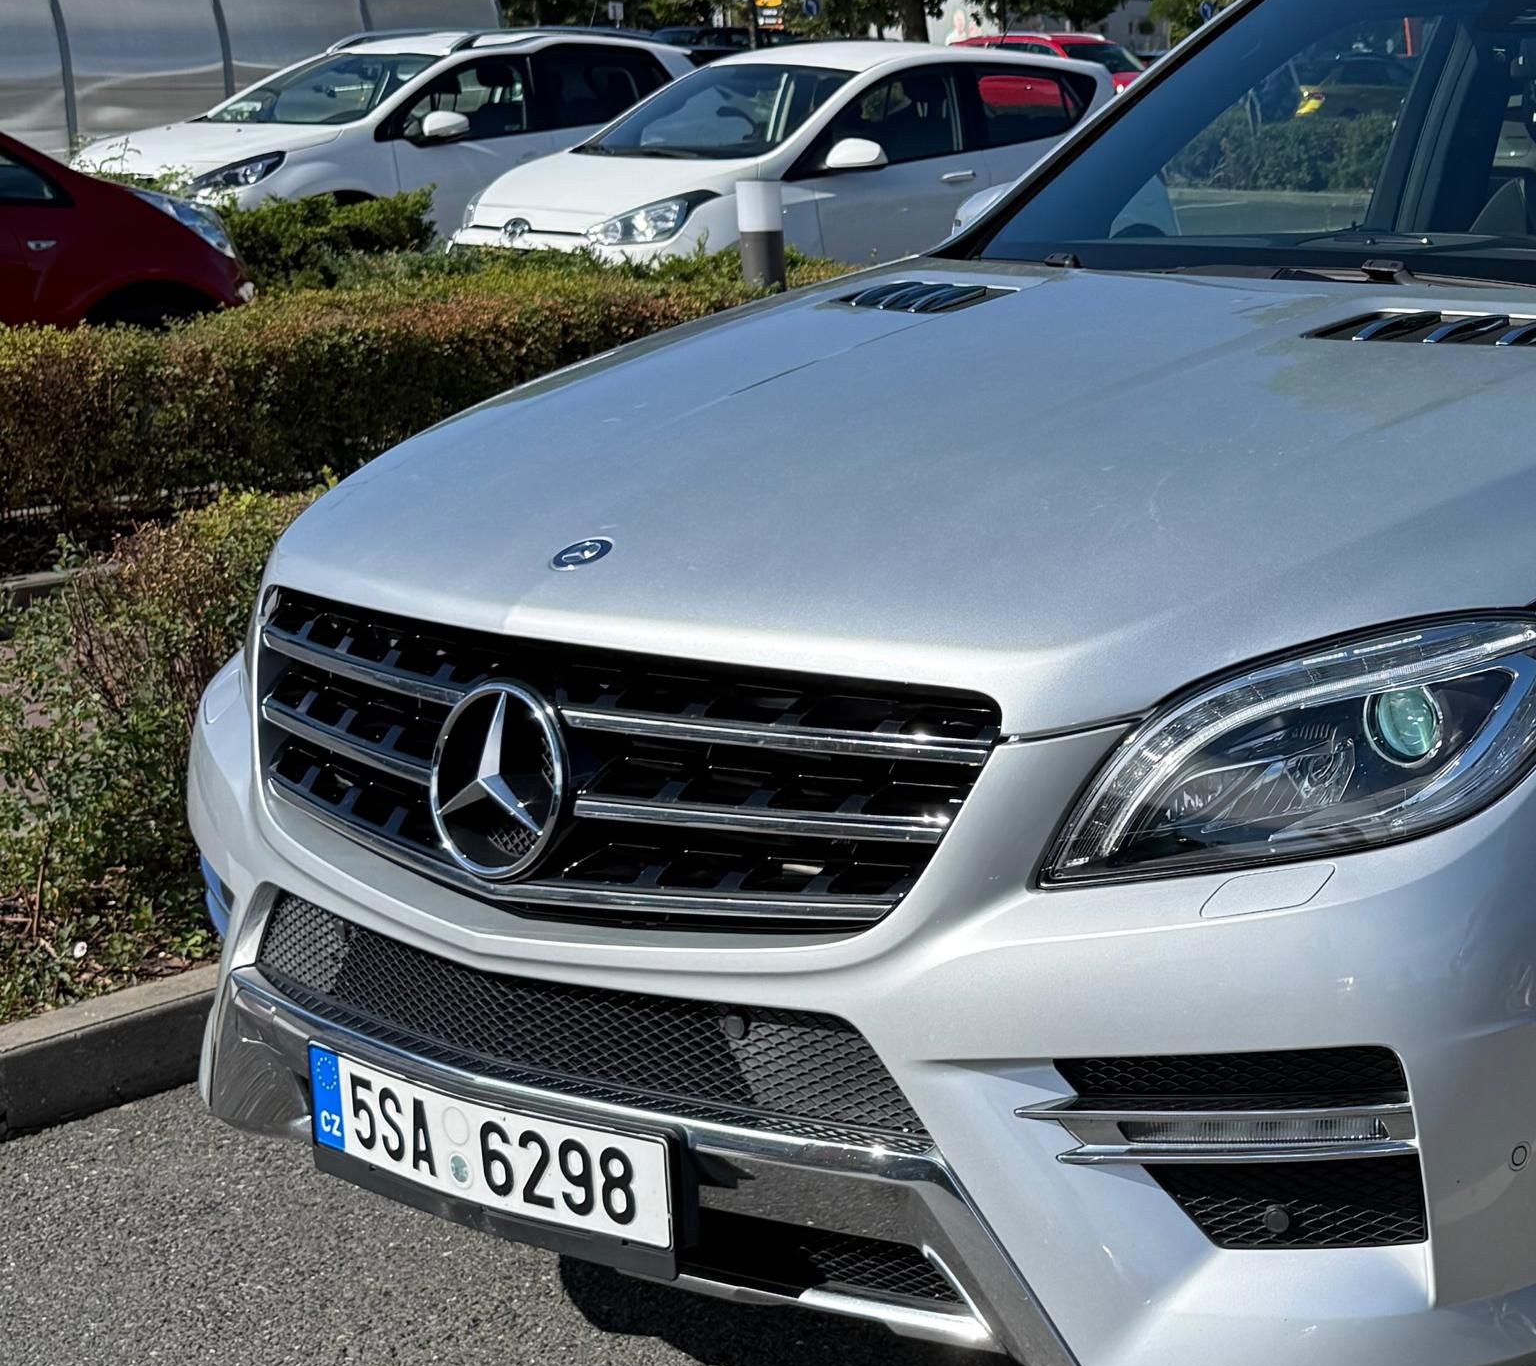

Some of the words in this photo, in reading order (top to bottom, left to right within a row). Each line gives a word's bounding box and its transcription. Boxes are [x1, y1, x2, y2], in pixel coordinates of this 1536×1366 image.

[320, 1109, 342, 1137] CZ
[349, 1072, 438, 1179] 5SA
[480, 1120, 636, 1226] 6298
